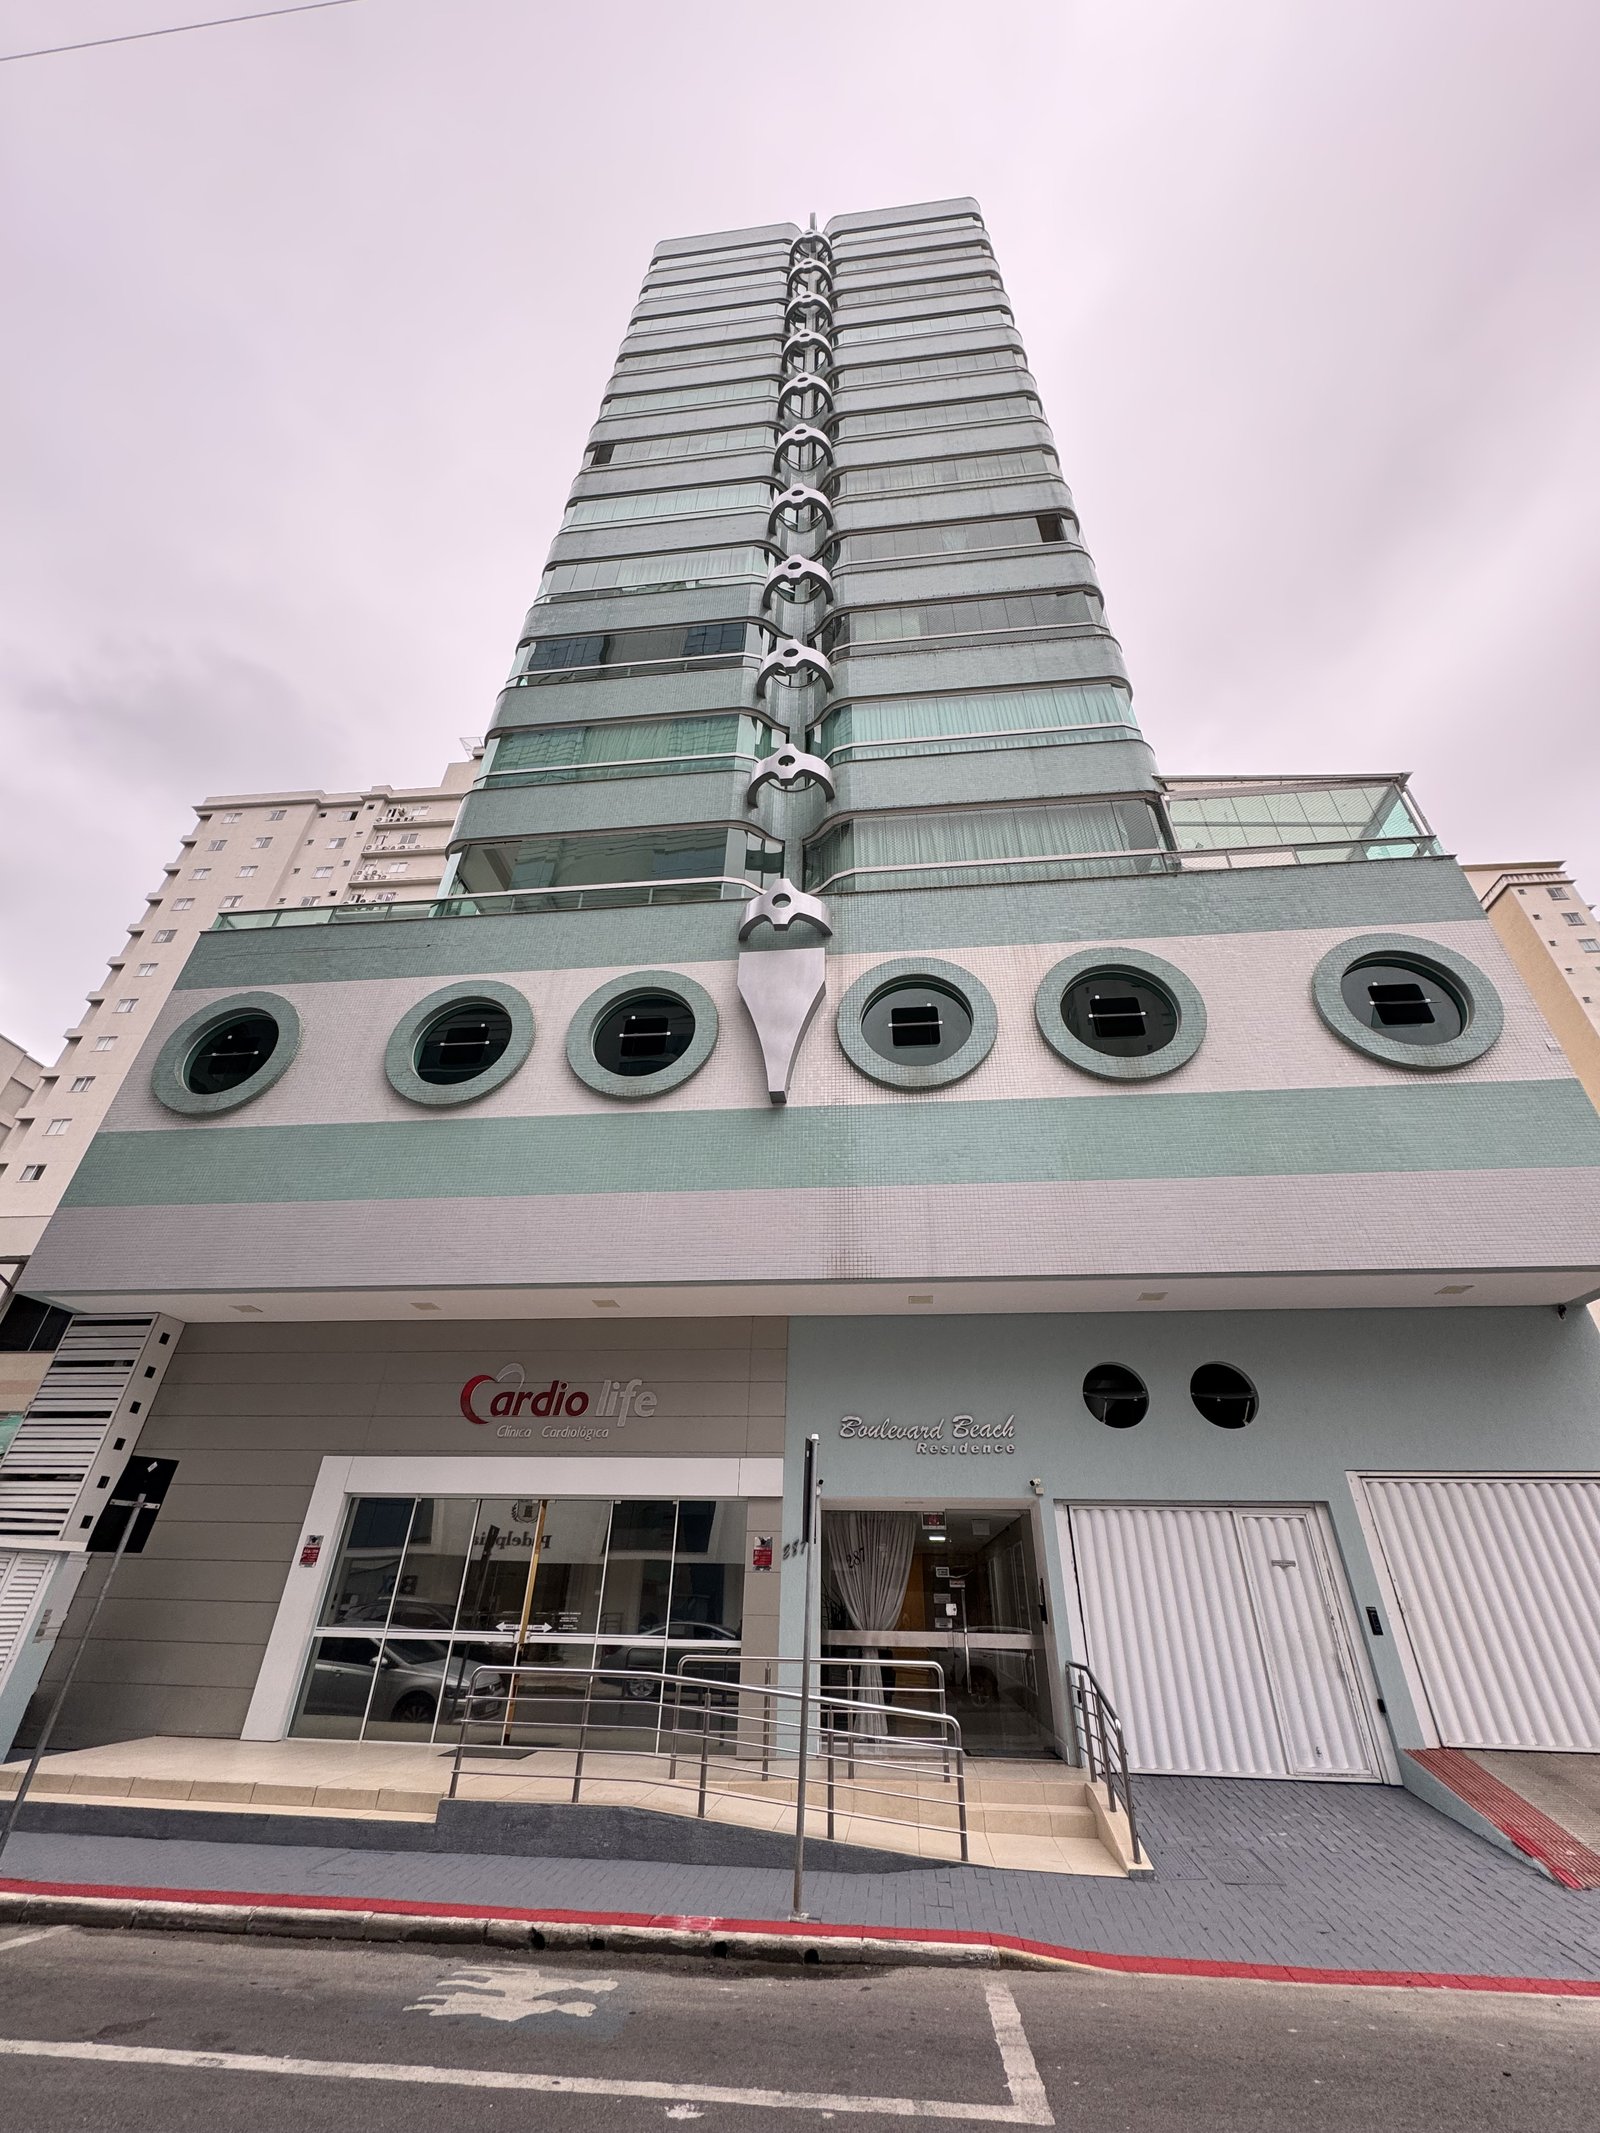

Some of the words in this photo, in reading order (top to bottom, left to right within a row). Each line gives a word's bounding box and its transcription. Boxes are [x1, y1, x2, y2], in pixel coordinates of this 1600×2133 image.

[460, 1375, 590, 1425] Cardio
[595, 1378, 658, 1427] life
[541, 1425, 609, 1441] Cardiológica
[839, 1414, 945, 1441] Boulevard
[952, 1414, 1015, 1439] Beach
[916, 1442, 1016, 1455] Residence
[845, 1546, 866, 1569] 287
